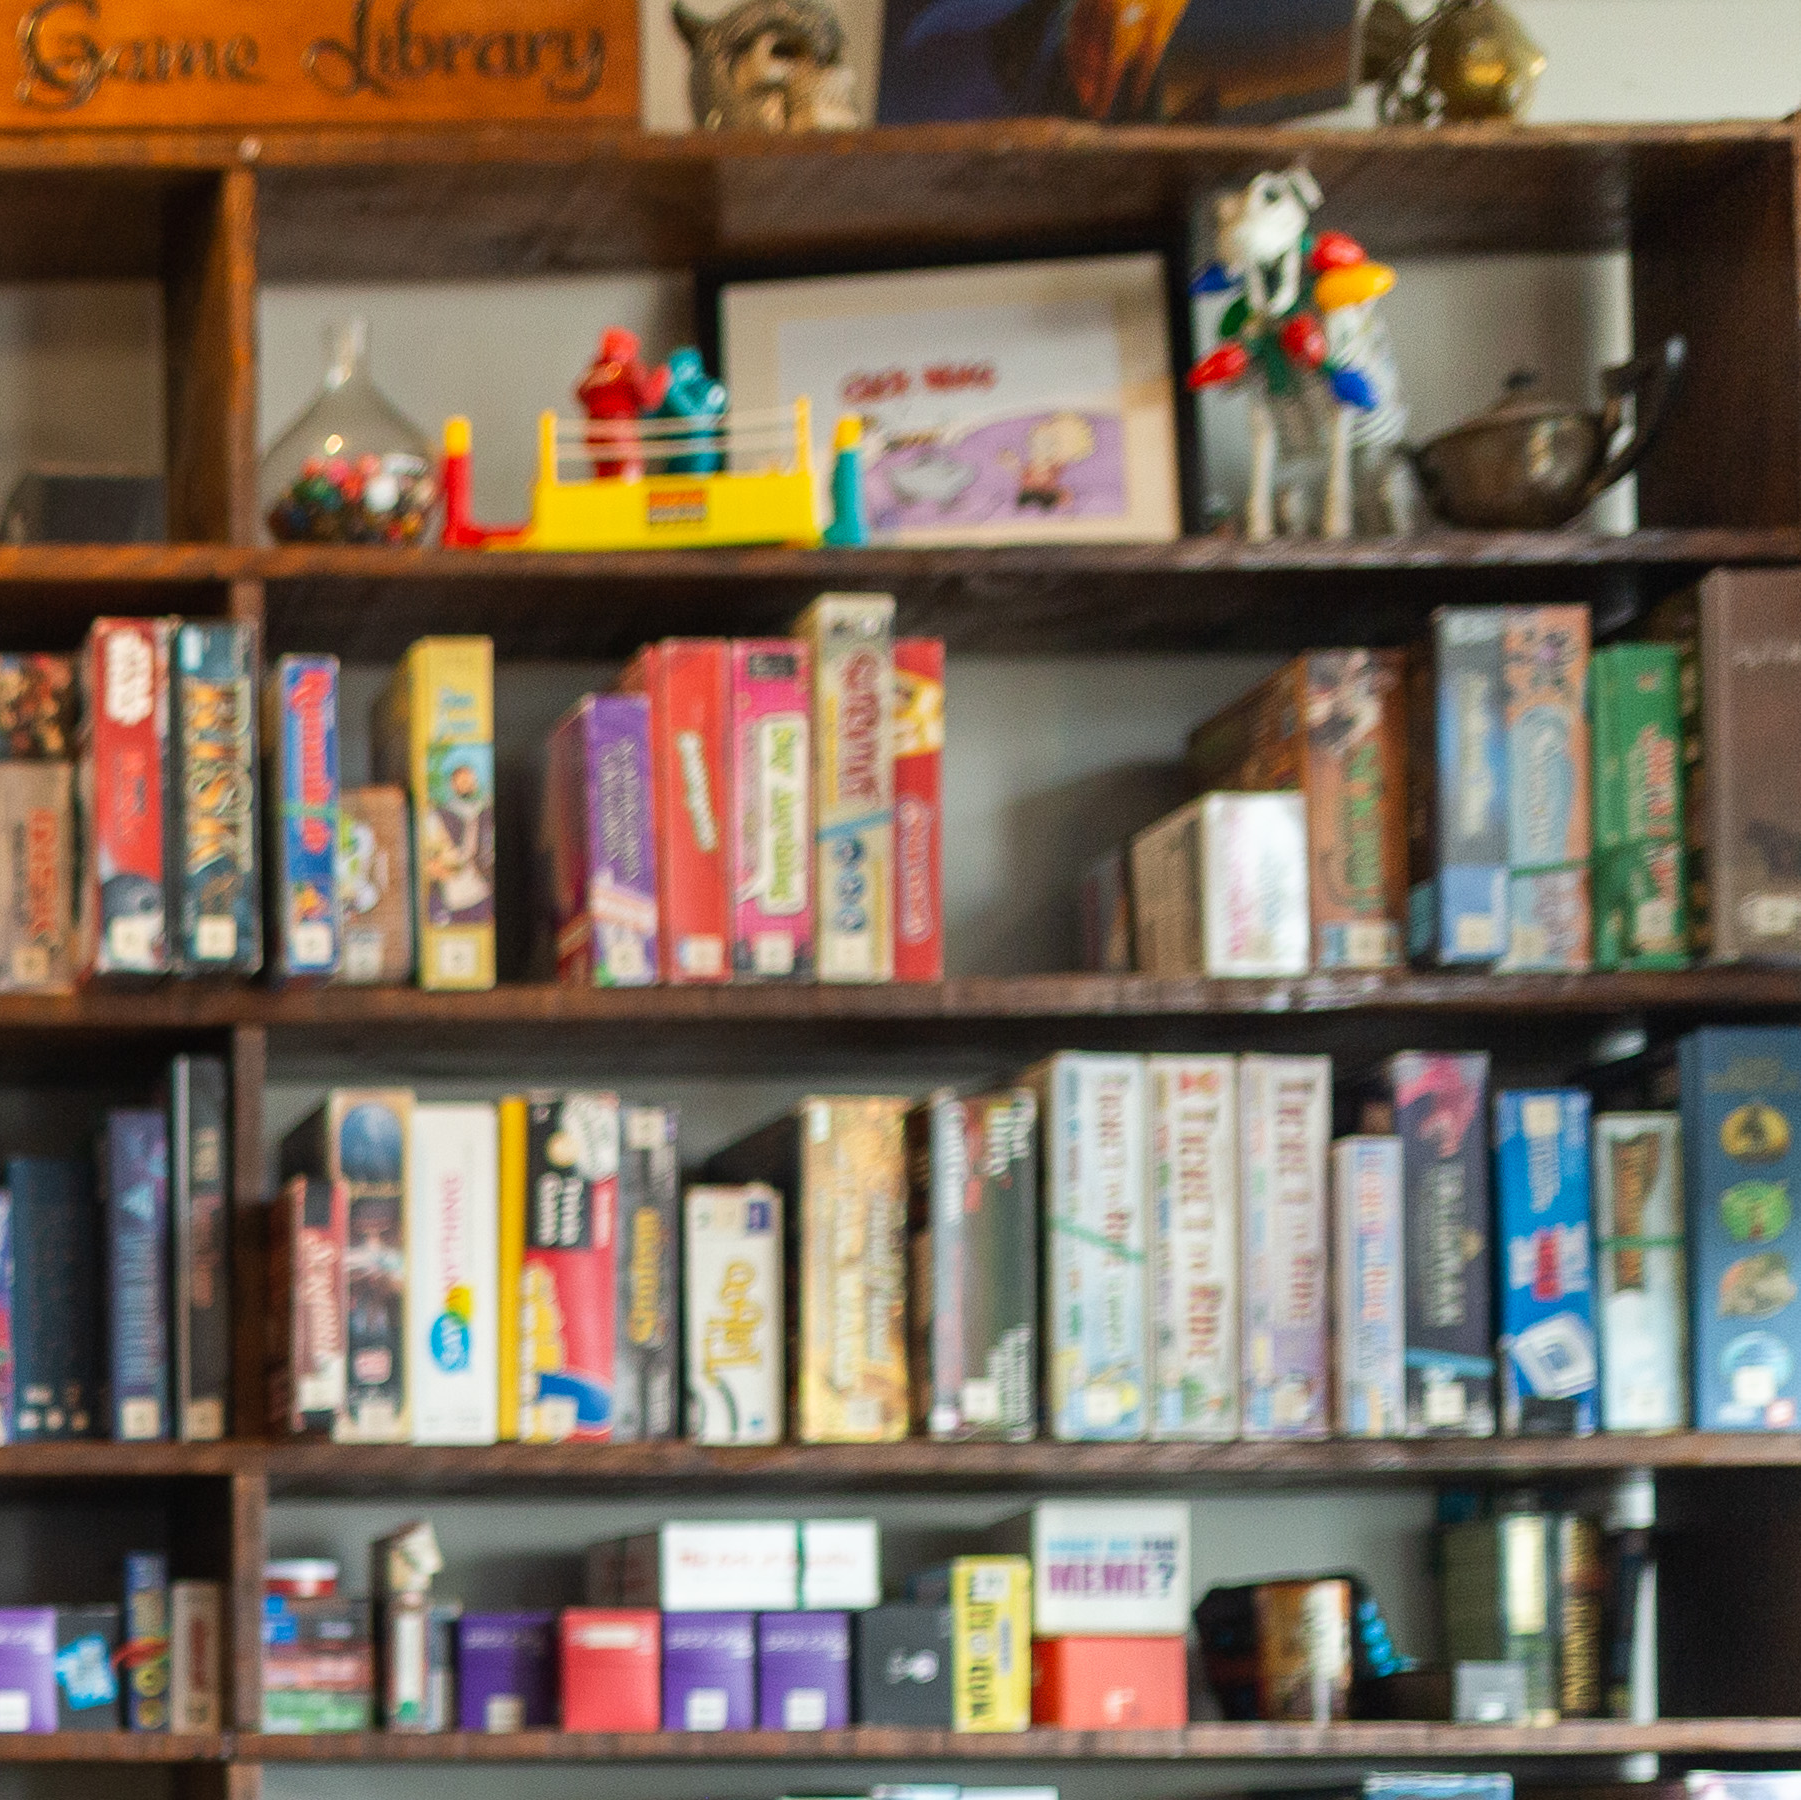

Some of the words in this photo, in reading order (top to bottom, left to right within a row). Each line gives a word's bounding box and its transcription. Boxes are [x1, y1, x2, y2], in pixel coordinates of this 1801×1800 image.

[14, 0, 261, 110] Game
[301, 0, 607, 103] Library
[1048, 1562, 1177, 1599] MEME?
